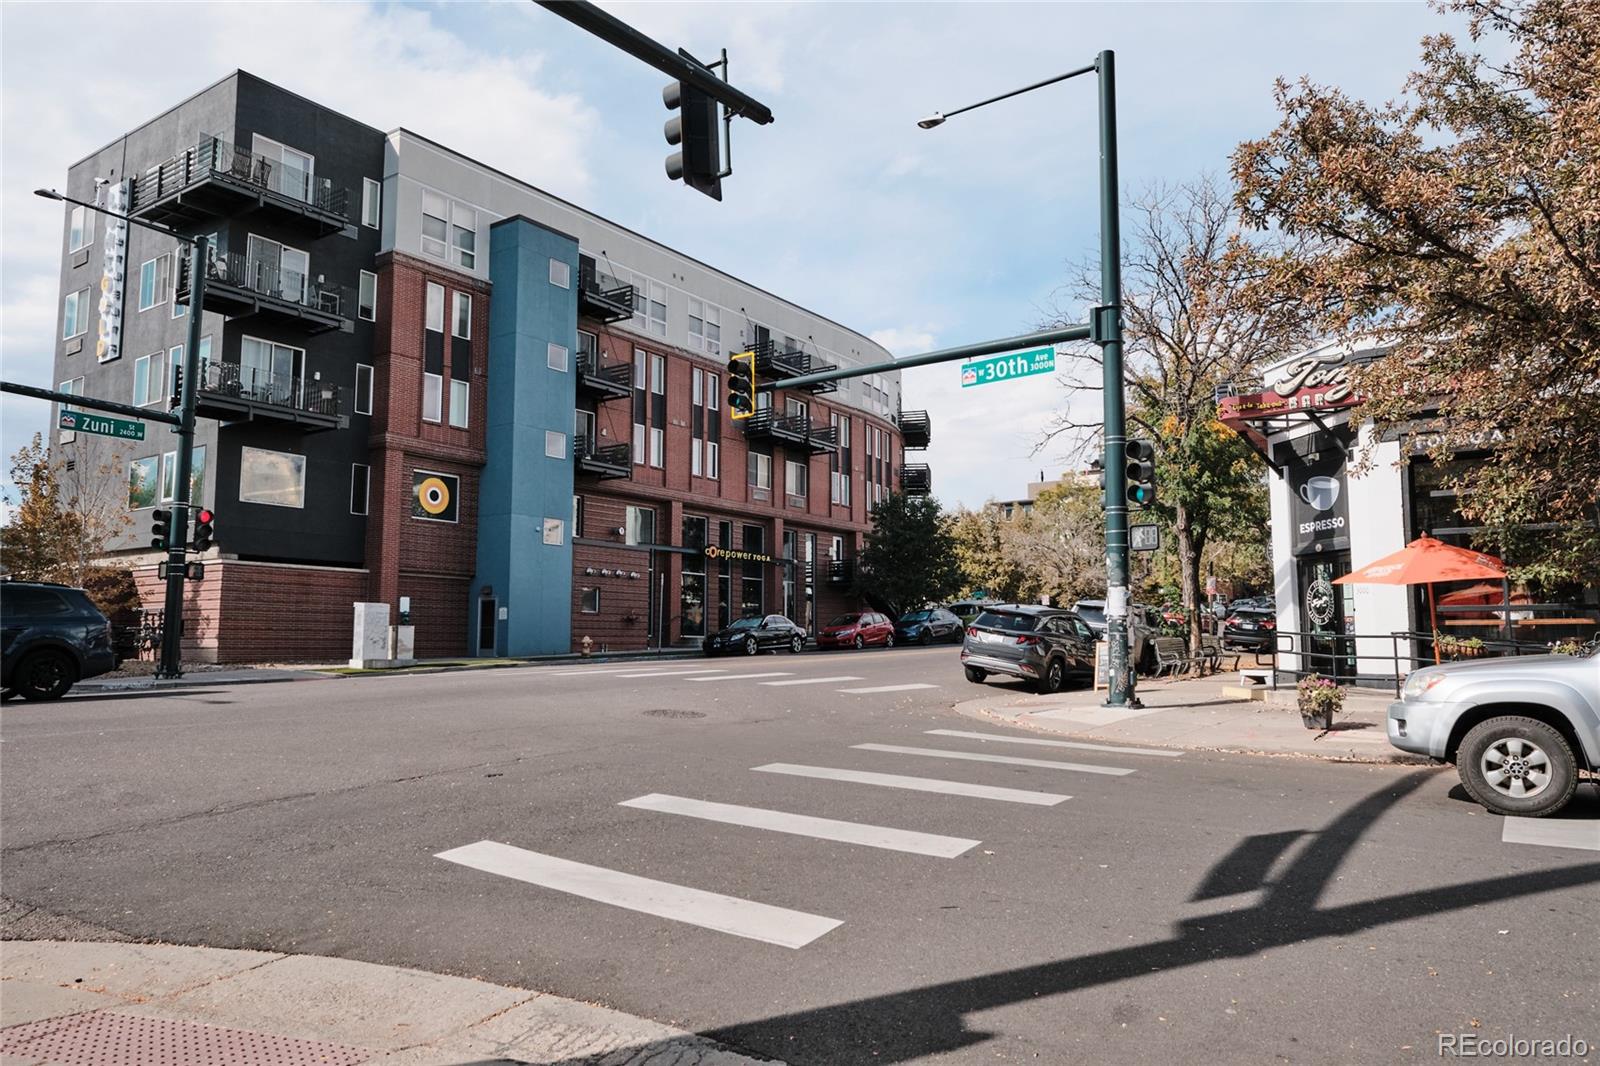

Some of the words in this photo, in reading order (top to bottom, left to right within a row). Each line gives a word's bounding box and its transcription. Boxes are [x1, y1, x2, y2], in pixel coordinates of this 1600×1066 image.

[1035, 353, 1048, 362] Ave
[986, 357, 1028, 379] 30th
[1030, 361, 1054, 371] 3000N
[82, 417, 114, 434] Zuni
[120, 429, 135, 437] 2400
[1299, 516, 1345, 534] ESPRESSO
